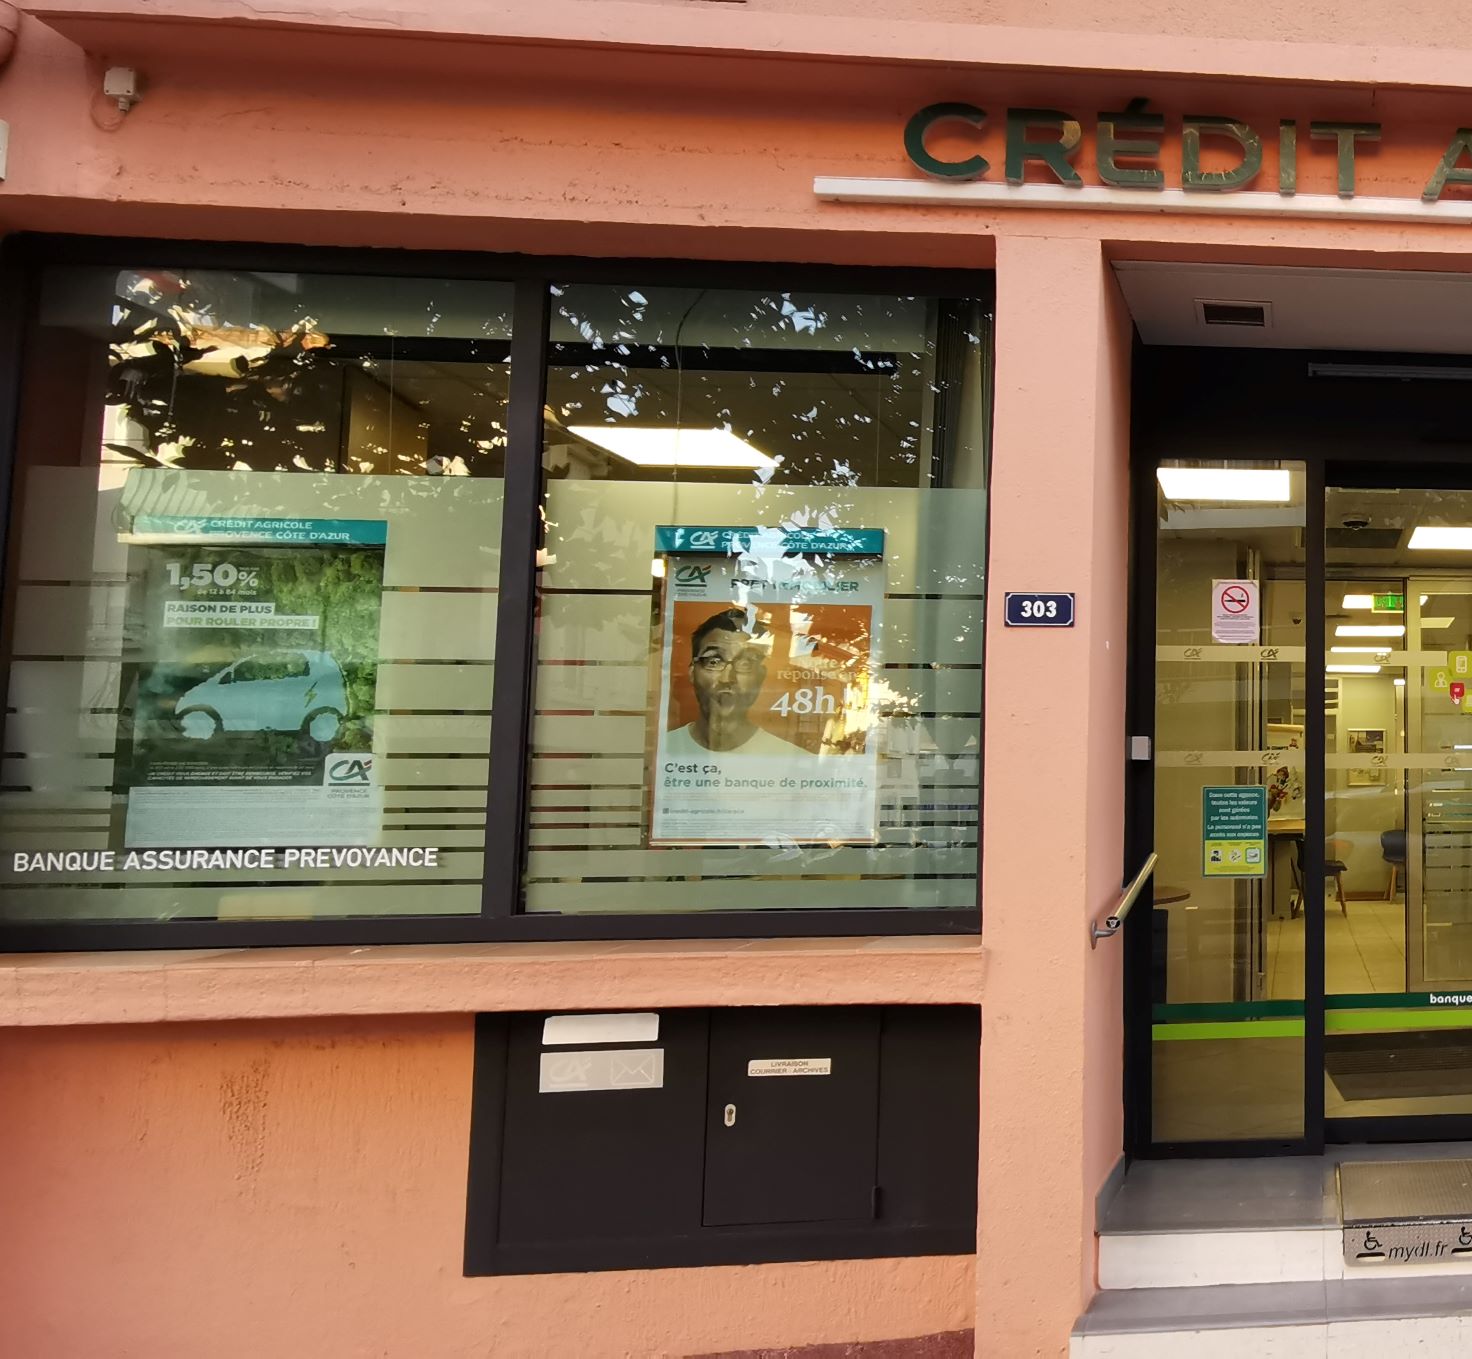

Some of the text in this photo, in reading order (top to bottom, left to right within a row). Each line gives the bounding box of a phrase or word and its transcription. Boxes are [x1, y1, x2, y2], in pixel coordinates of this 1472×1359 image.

[903, 97, 1382, 200] CRÉDIT
[210, 519, 313, 530] CRÉDIT AGRICOLE
[209, 530, 350, 541] OVENCE CÔTE D'AZUR
[166, 604, 273, 614] RAISON DE PLUS
[1020, 600, 1057, 618] 303
[166, 616, 203, 626] POUR
[205, 617, 257, 627] ROULER
[259, 618, 310, 628] PROPRE
[769, 685, 836, 717] 48h
[702, 764, 722, 776] ça,
[664, 776, 868, 790] être une banque de proximité.
[13, 847, 440, 873] BANQUE ASSURANCE PREVOYANCE
[1430, 993, 1472, 1006] banque
[750, 1067, 788, 1075] COURRIER
[1388, 1240, 1449, 1262] mydl.fr
